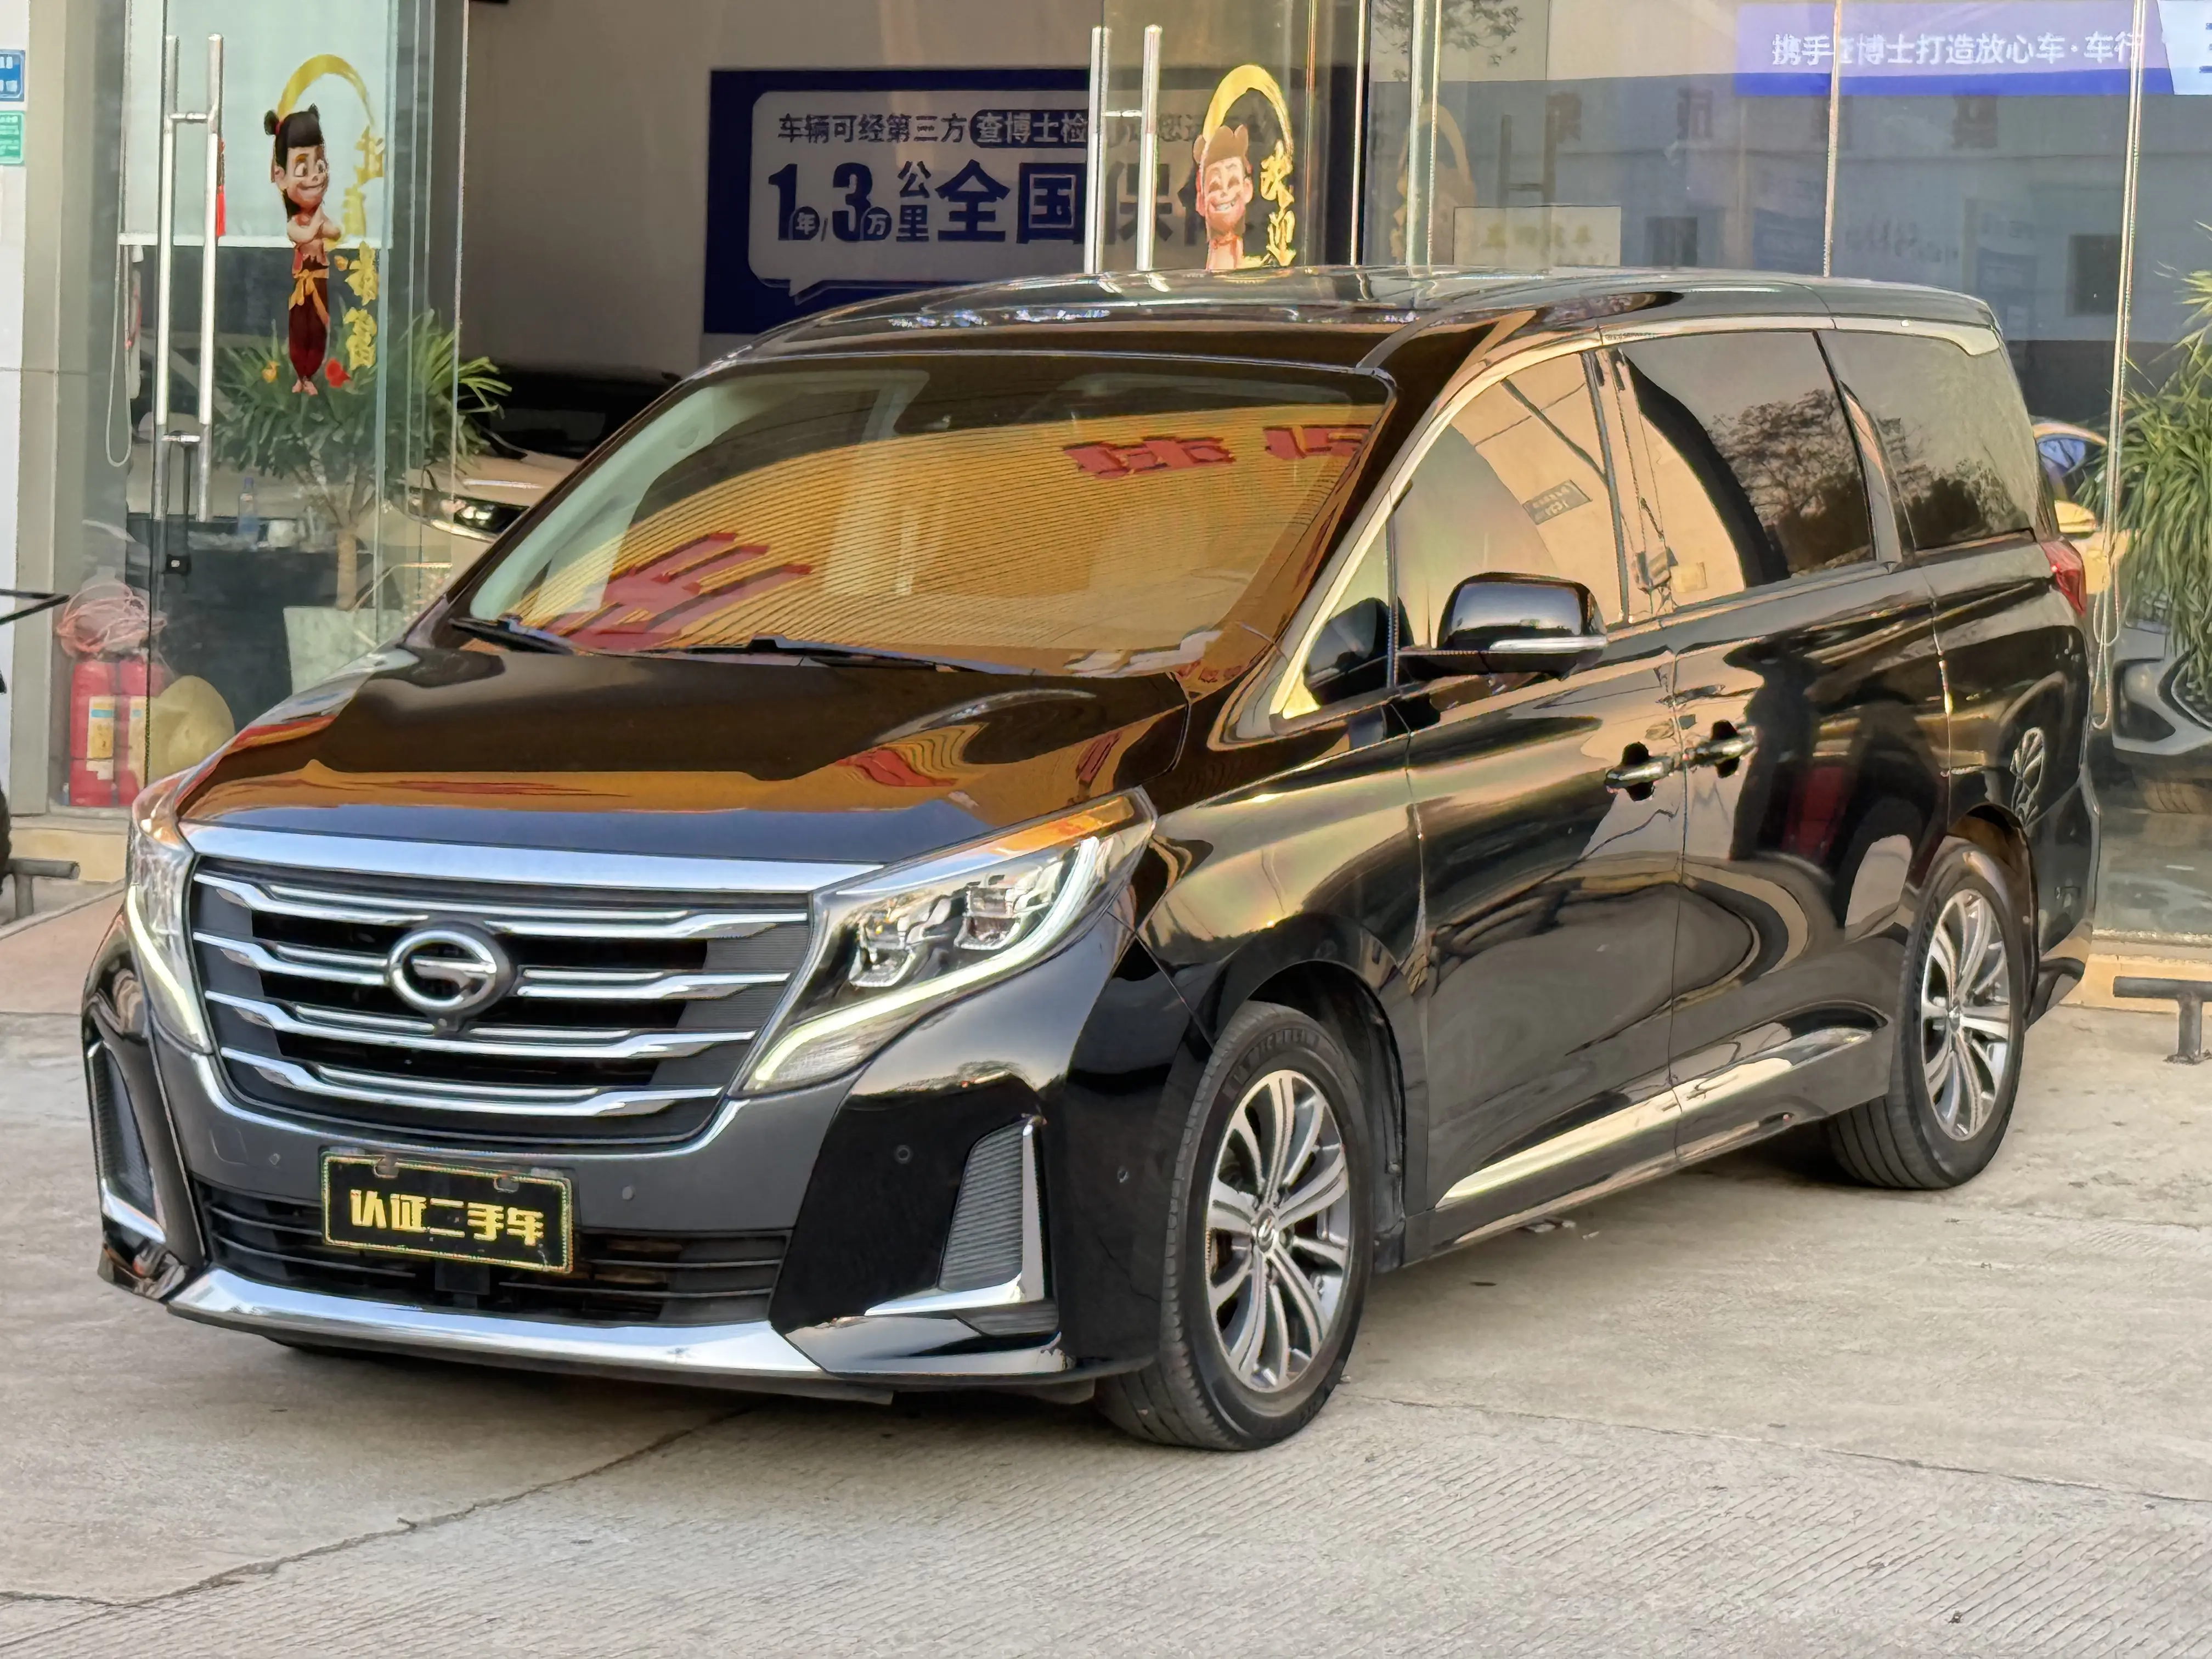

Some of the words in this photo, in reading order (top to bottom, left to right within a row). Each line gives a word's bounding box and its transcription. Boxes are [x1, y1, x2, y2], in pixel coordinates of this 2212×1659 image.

[349, 1189, 544, 1246] 认证二手车
